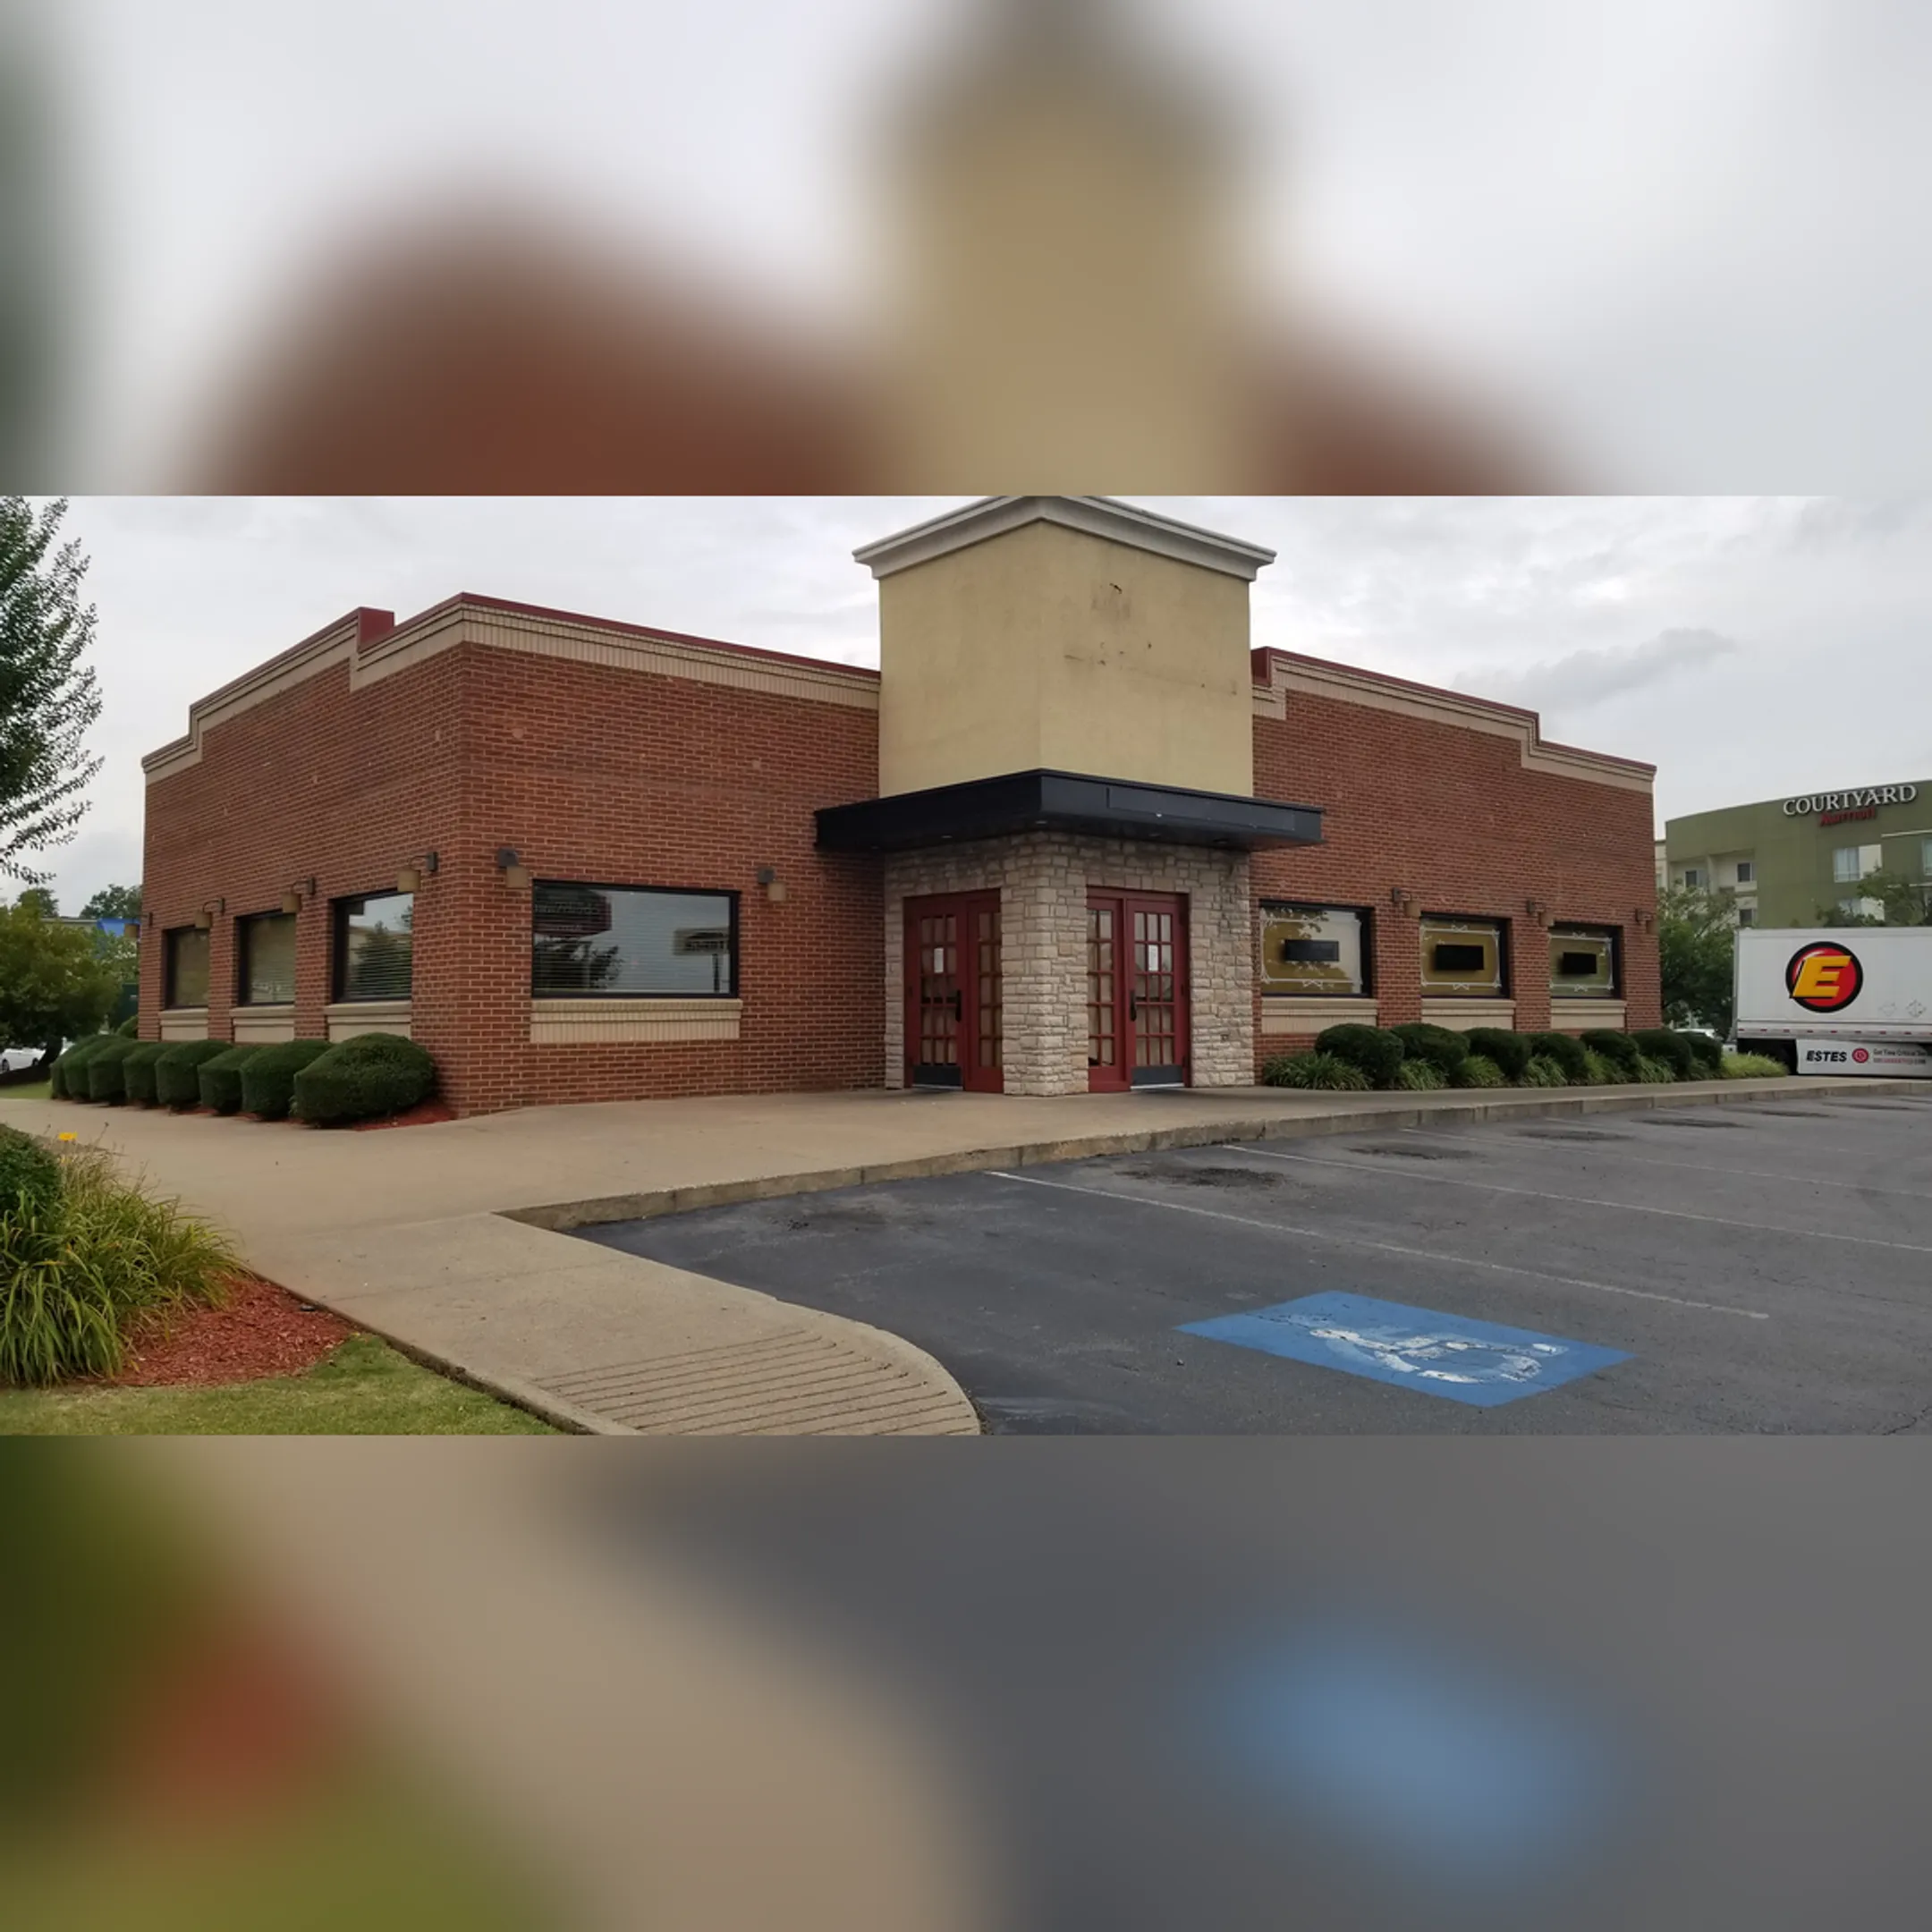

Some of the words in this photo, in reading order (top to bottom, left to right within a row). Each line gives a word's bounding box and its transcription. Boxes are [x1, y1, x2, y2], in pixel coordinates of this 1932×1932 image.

[1783, 784, 1918, 816] COURTYARD
[1789, 954, 1852, 999] E
[1806, 1050, 1848, 1063] ESTES
